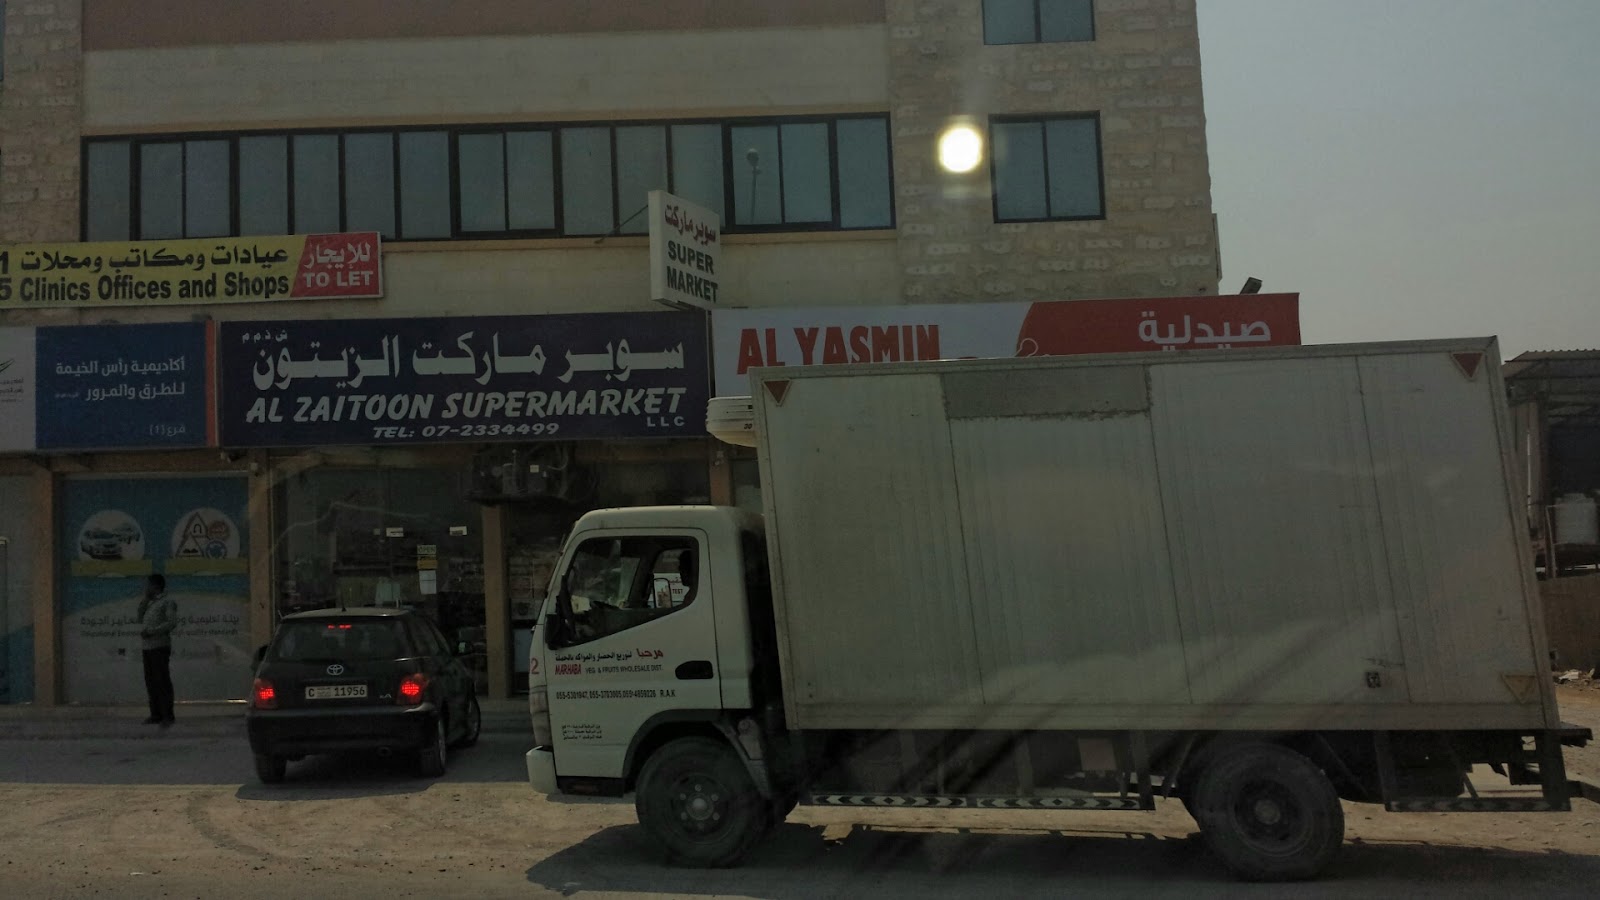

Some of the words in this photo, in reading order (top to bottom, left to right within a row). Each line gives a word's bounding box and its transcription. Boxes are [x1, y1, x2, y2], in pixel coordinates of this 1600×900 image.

[21, 250, 103, 274] ومحلات
[109, 247, 206, 274] ومكاتب
[210, 244, 288, 270] عيادات
[667, 240, 714, 275] SUPER
[20, 276, 91, 302] Clinics
[97, 275, 172, 300] Offices
[178, 273, 217, 299] and
[224, 271, 290, 299] Shops
[303, 272, 330, 288] TO
[336, 270, 373, 288] LET
[666, 265, 719, 304] MARKET
[738, 328, 785, 370] AL
[793, 324, 940, 365] YASMIN
[1138, 310, 1272, 352] صيدلية
[252, 334, 401, 391] الزيتون
[412, 331, 547, 386] ماركت
[556, 338, 685, 385] سوبر
[245, 396, 284, 423] AL
[292, 393, 435, 423] ZAITOON
[441, 387, 688, 420] SUPERMARKET
[373, 426, 416, 439] TEL:
[422, 422, 561, 439] 07-2334499
[531, 657, 540, 675] 2
[308, 688, 316, 698] C
[334, 686, 366, 697] 11956
